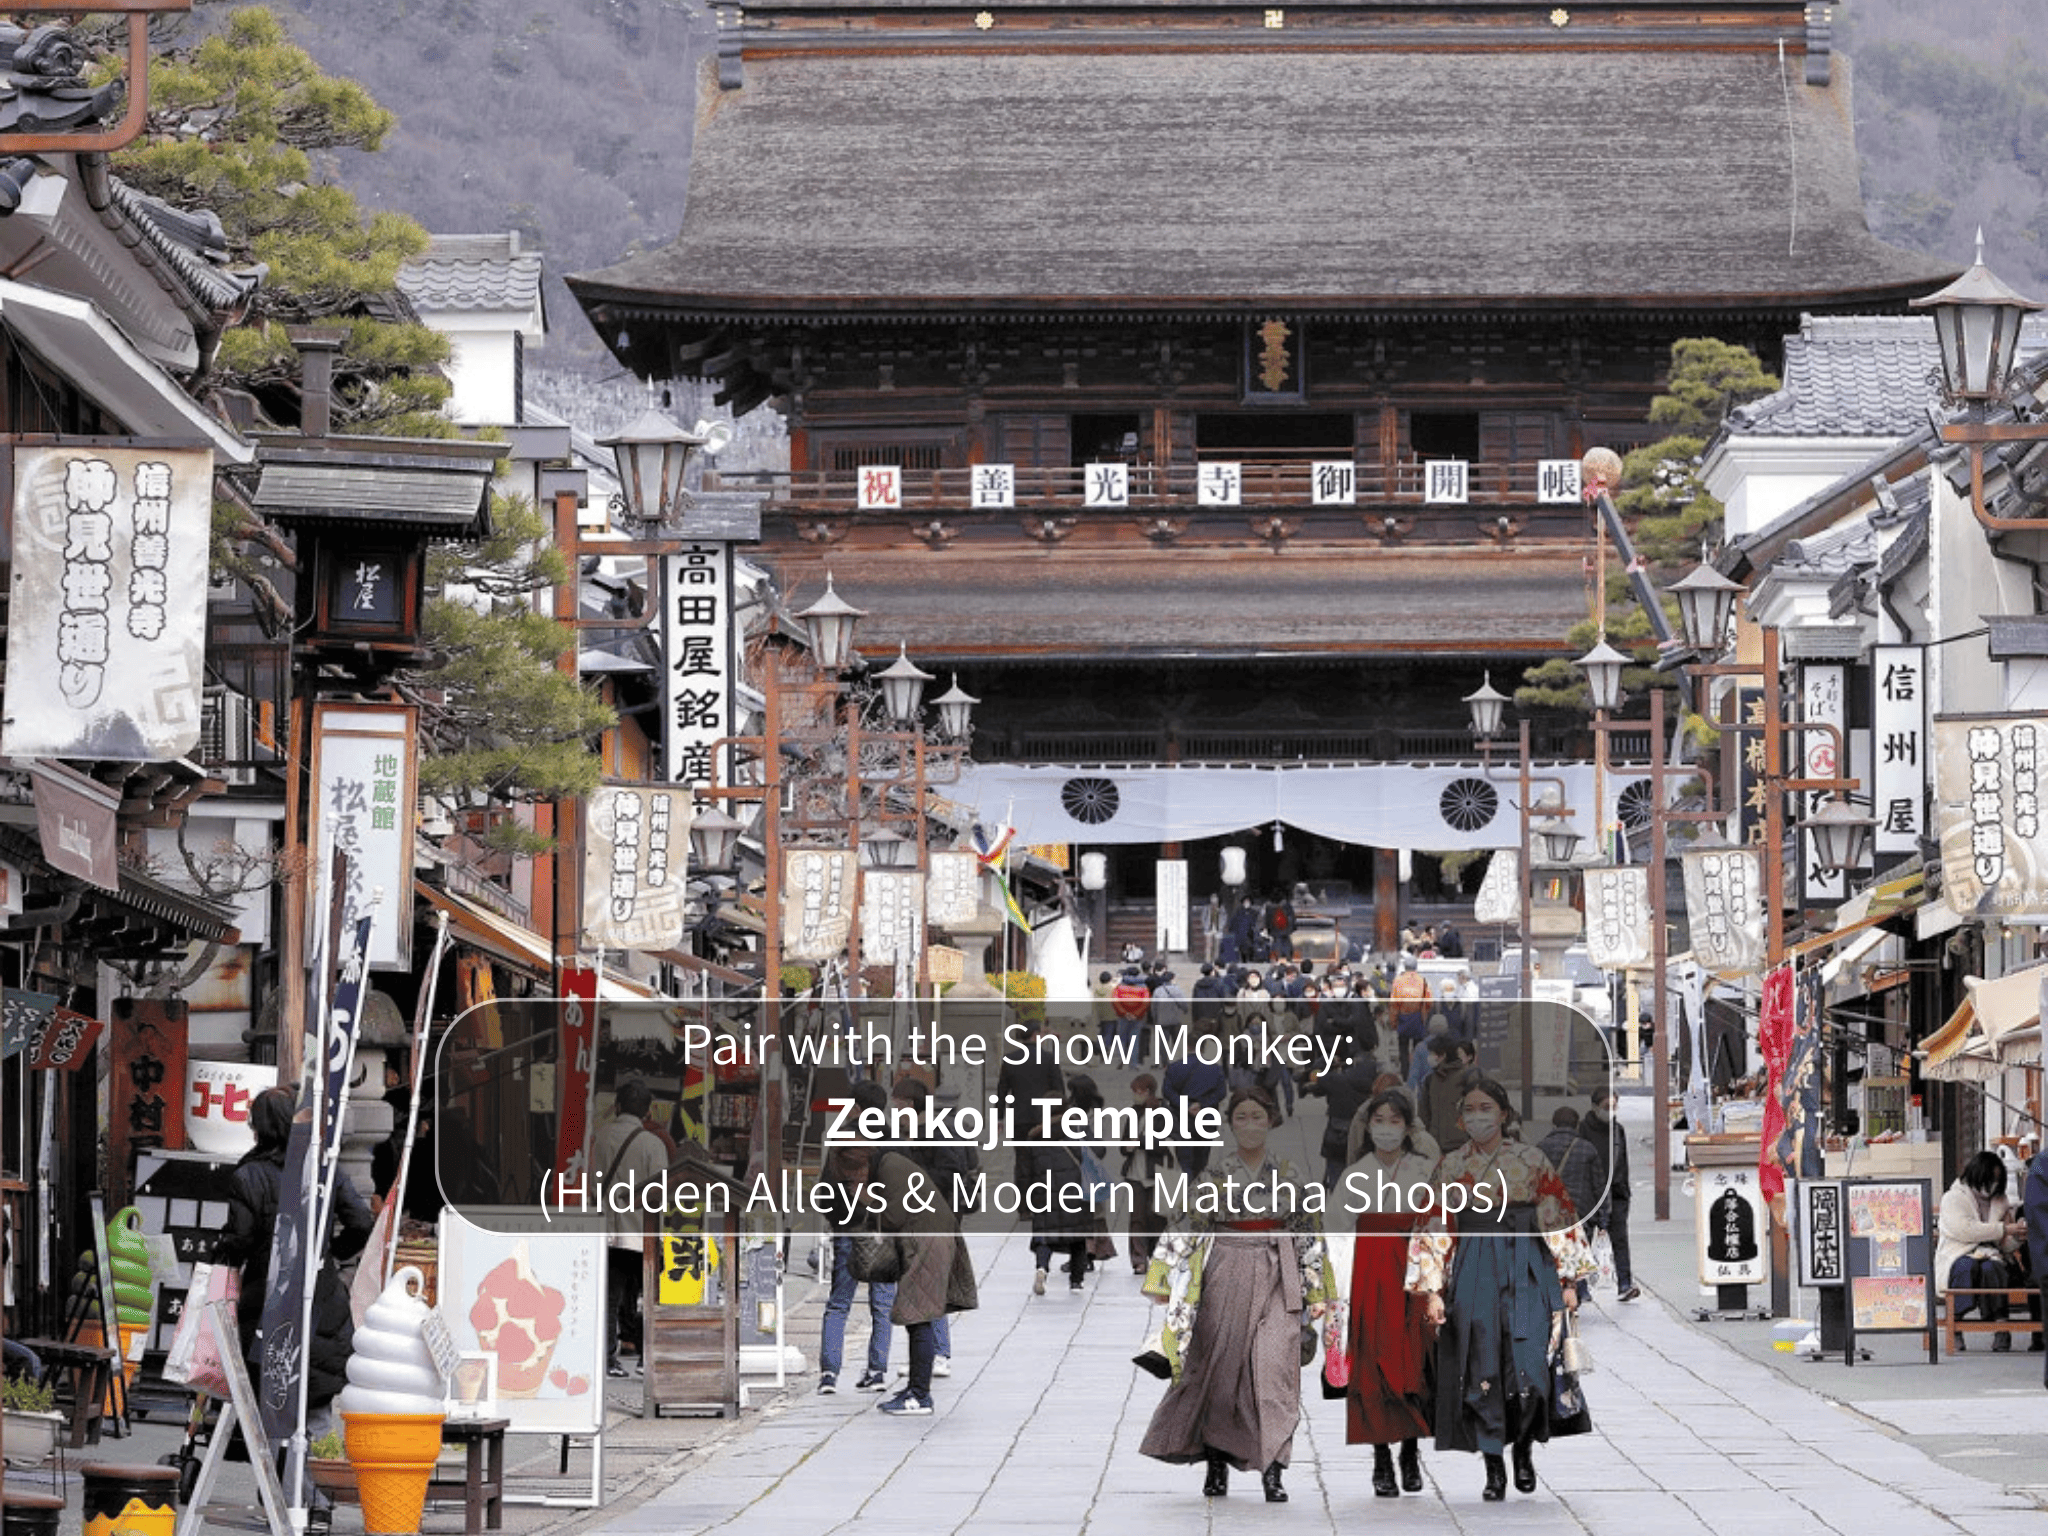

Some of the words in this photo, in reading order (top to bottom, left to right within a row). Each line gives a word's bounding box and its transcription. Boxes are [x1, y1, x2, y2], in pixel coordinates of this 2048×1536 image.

[864, 463, 1577, 505] 祝善光寺御開帳
[355, 562, 380, 610] 松屋
[673, 545, 722, 813] 高田屋銘産
[1882, 664, 1917, 835] 信州屋
[371, 754, 398, 831] 地蔵館
